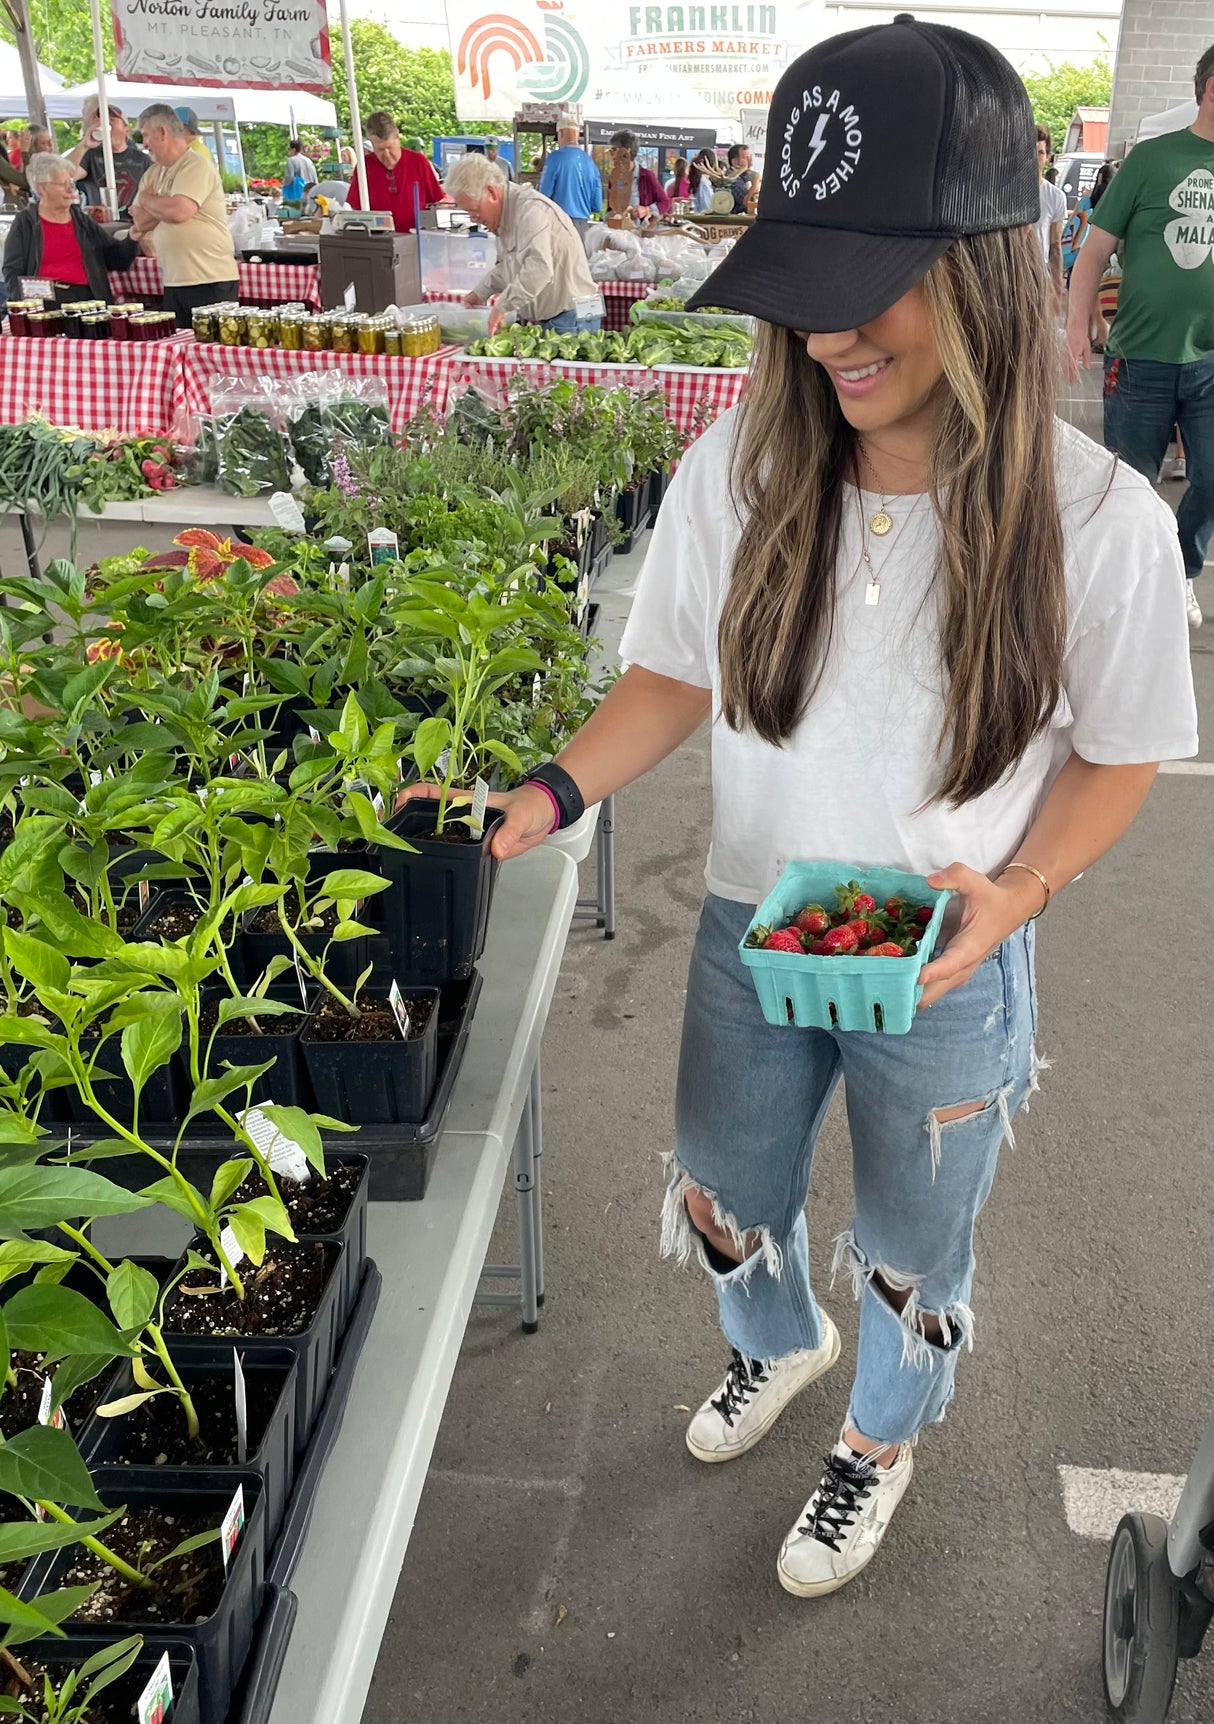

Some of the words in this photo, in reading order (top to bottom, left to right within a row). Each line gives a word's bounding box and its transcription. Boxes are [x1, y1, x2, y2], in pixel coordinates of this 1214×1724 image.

[127, 0, 191, 17] Norton
[196, 0, 259, 26] Family
[264, 0, 310, 22] Farm
[629, 5, 776, 35] FRANKLIN
[147, 22, 173, 34] MT.
[181, 25, 266, 41] PLEASANT,
[273, 28, 292, 40] TN
[626, 41, 706, 57] FARMERS
[711, 40, 782, 56] MARKET
[803, 85, 822, 112] AS
[826, 89, 840, 112] A
[659, 132, 677, 140] FINE
[678, 133, 695, 141] ART
[780, 106, 800, 198] STRONG
[813, 105, 862, 200] MOTHER
[1187, 177, 1213, 190] PRONE
[1177, 191, 1214, 210] SHENA
[718, 227, 743, 238] CHEWS
[1176, 226, 1214, 245] MALA
